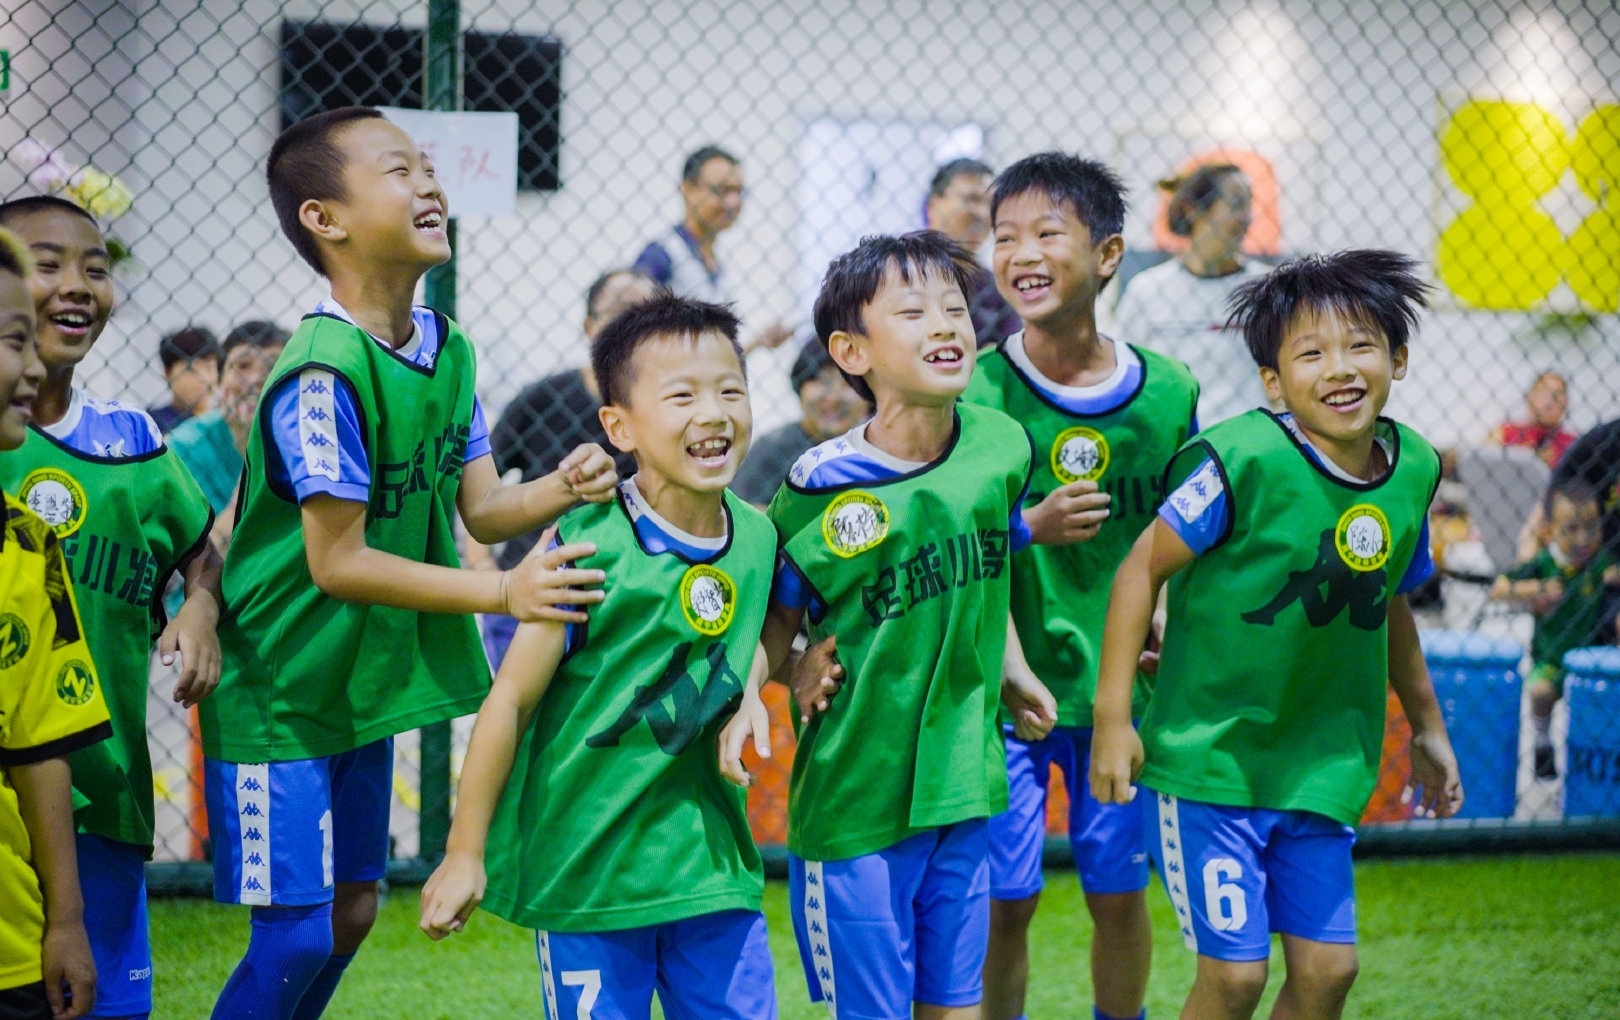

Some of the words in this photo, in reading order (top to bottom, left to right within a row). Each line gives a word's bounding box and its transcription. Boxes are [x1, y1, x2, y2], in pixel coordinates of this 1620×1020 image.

[319, 810, 334, 888] 1
[1202, 857, 1247, 932] 6
[561, 969, 602, 1020] 7
